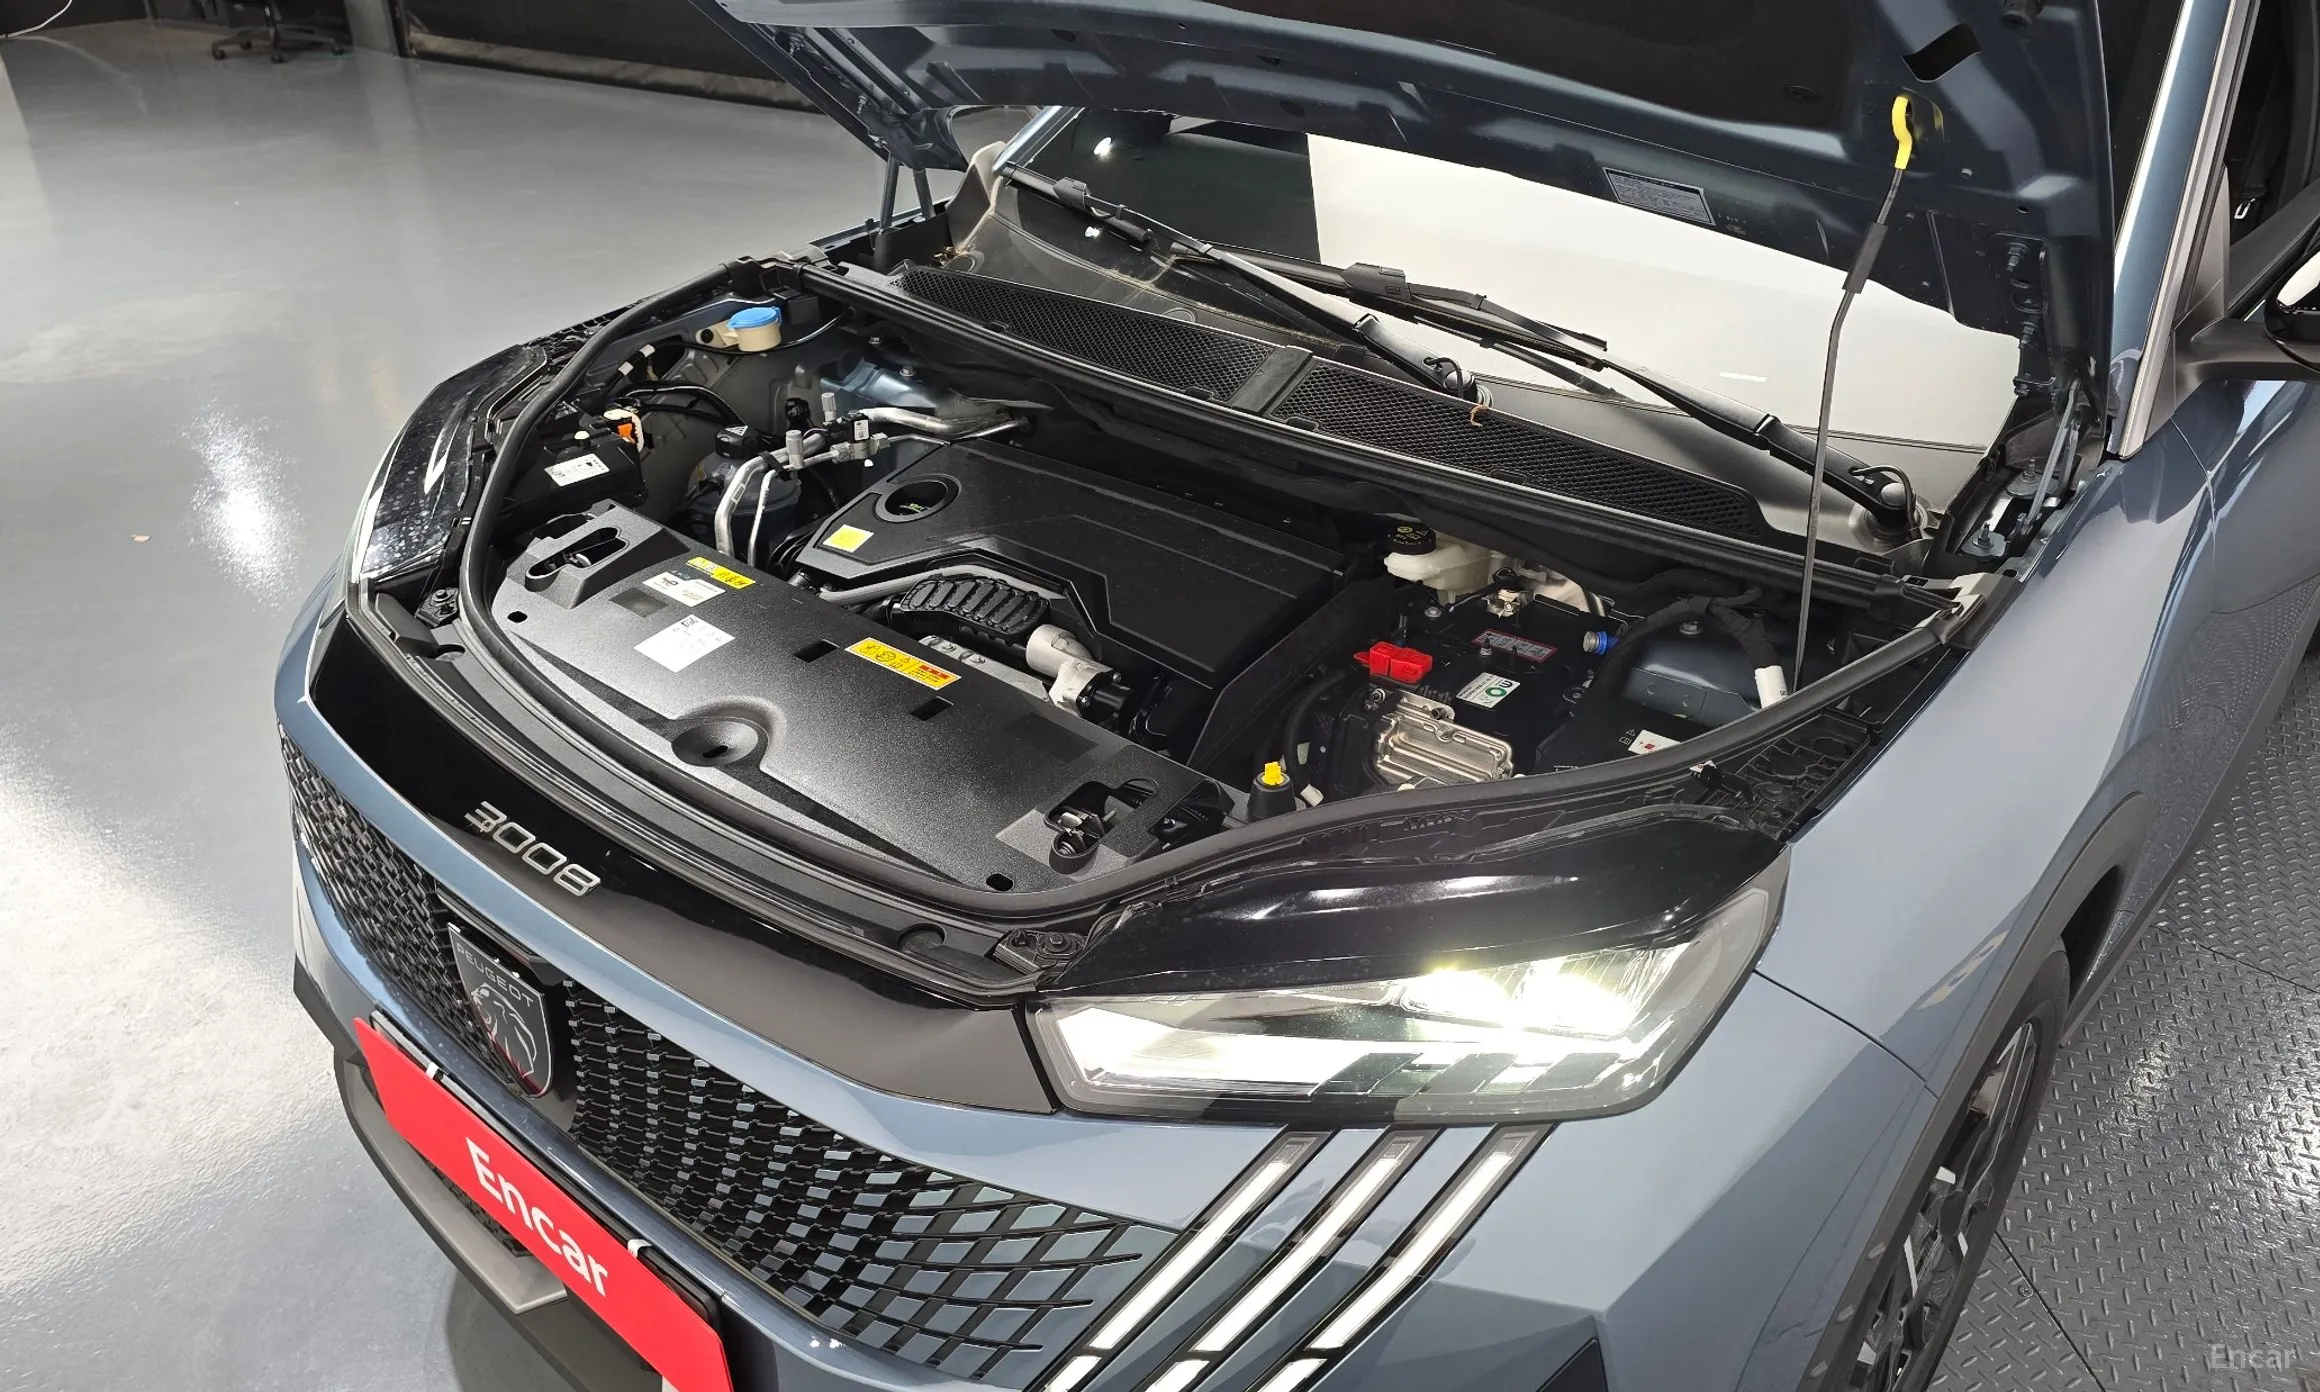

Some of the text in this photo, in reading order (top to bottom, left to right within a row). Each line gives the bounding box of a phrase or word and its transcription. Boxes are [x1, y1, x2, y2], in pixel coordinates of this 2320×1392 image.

[464, 800, 602, 897] 3008
[456, 942, 534, 1008] PEUGEOT
[465, 1136, 609, 1297] Encar
